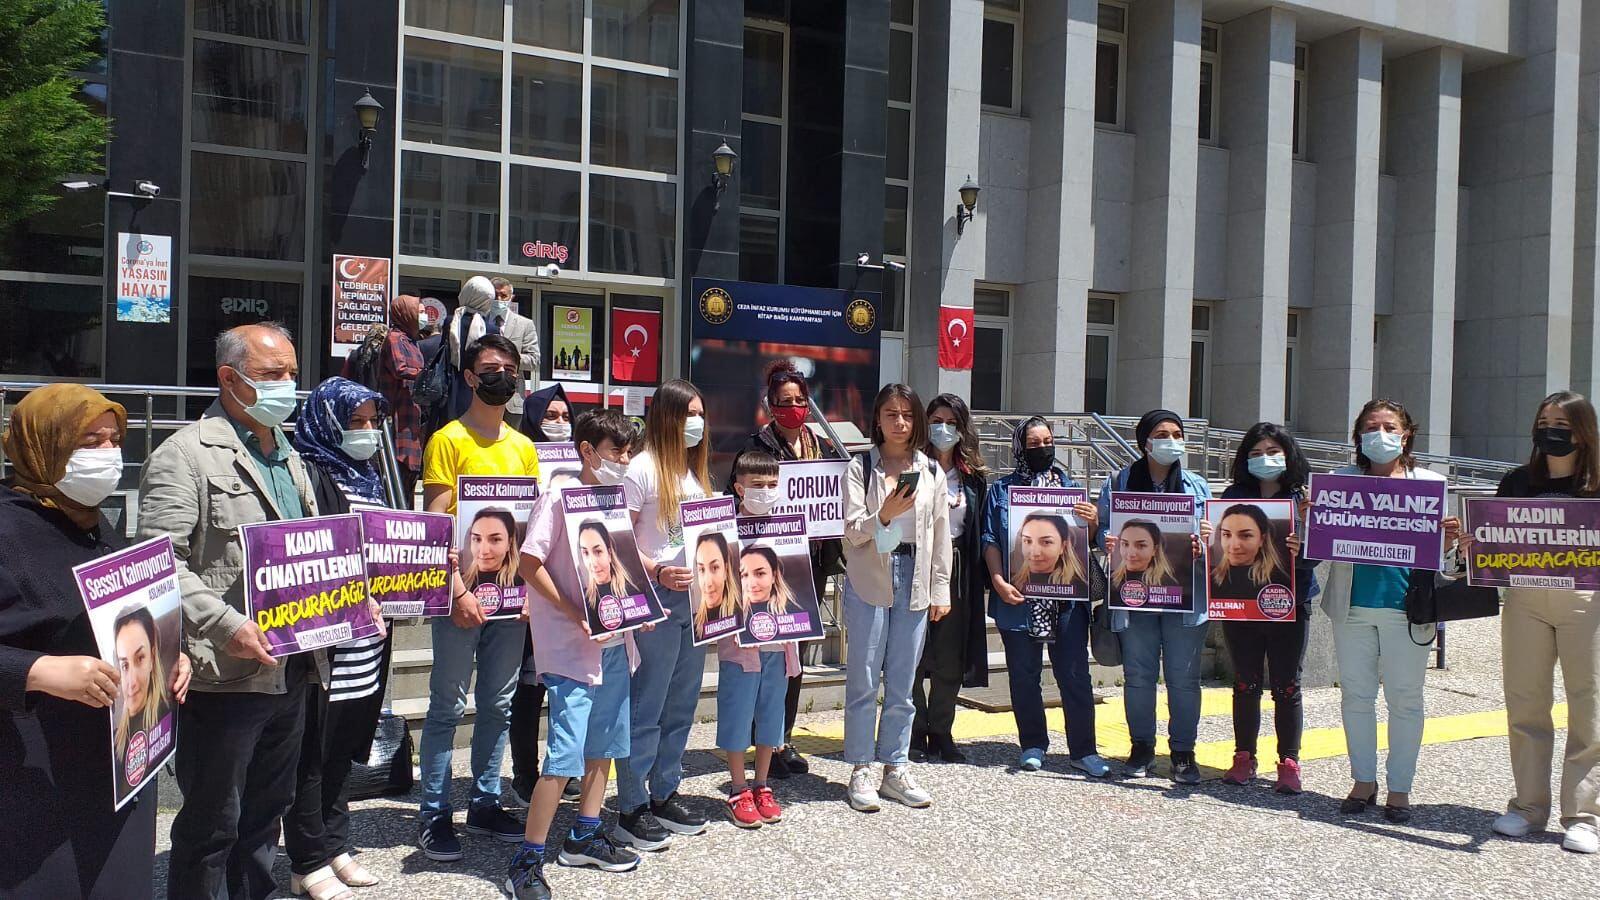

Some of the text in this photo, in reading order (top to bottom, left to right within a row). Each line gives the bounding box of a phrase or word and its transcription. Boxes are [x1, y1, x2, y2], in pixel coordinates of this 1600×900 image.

[523, 240, 568, 263] GİRİŞ
[122, 267, 167, 282] YAŞASIN
[122, 282, 167, 298] HAYAT
[340, 281, 384, 292] TEDBİRLER
[340, 291, 382, 302] HEPİMİZİN
[372, 304, 382, 312] ve
[338, 312, 384, 323] ÜLKEMİZİN
[464, 482, 494, 496] Sessiz
[788, 475, 838, 501] ÇORUM
[566, 494, 588, 509] Sessiz
[1012, 492, 1036, 504] Sessiz
[1114, 498, 1190, 513] Sessiz Kalmıyoruz!
[1314, 490, 1440, 515] ASLA YALNIZ
[809, 499, 844, 522] MECLİ
[1507, 507, 1565, 524] KADIN
[385, 520, 426, 540] KADIN
[738, 523, 754, 536] ssiz
[755, 520, 802, 535] Kalmıyoruz!
[1314, 510, 1438, 534] YÜRÜMEYECEKSİN
[285, 529, 334, 556] KADIN
[1475, 522, 1600, 546] CİNAYETLERİN
[364, 538, 448, 564] CİNAYETLERİNİ
[1336, 543, 1412, 560] KADINMECLİSLERİ
[85, 548, 172, 600] Sessiz Kalmıyoruz!
[255, 547, 363, 592] CİNAYETLERİNİ
[370, 568, 447, 595] URDURACAĞIZ
[257, 580, 365, 632] DURDURACAĞIZ
[1210, 602, 1244, 610] ASLIHAN
[1210, 610, 1226, 618] DAL
